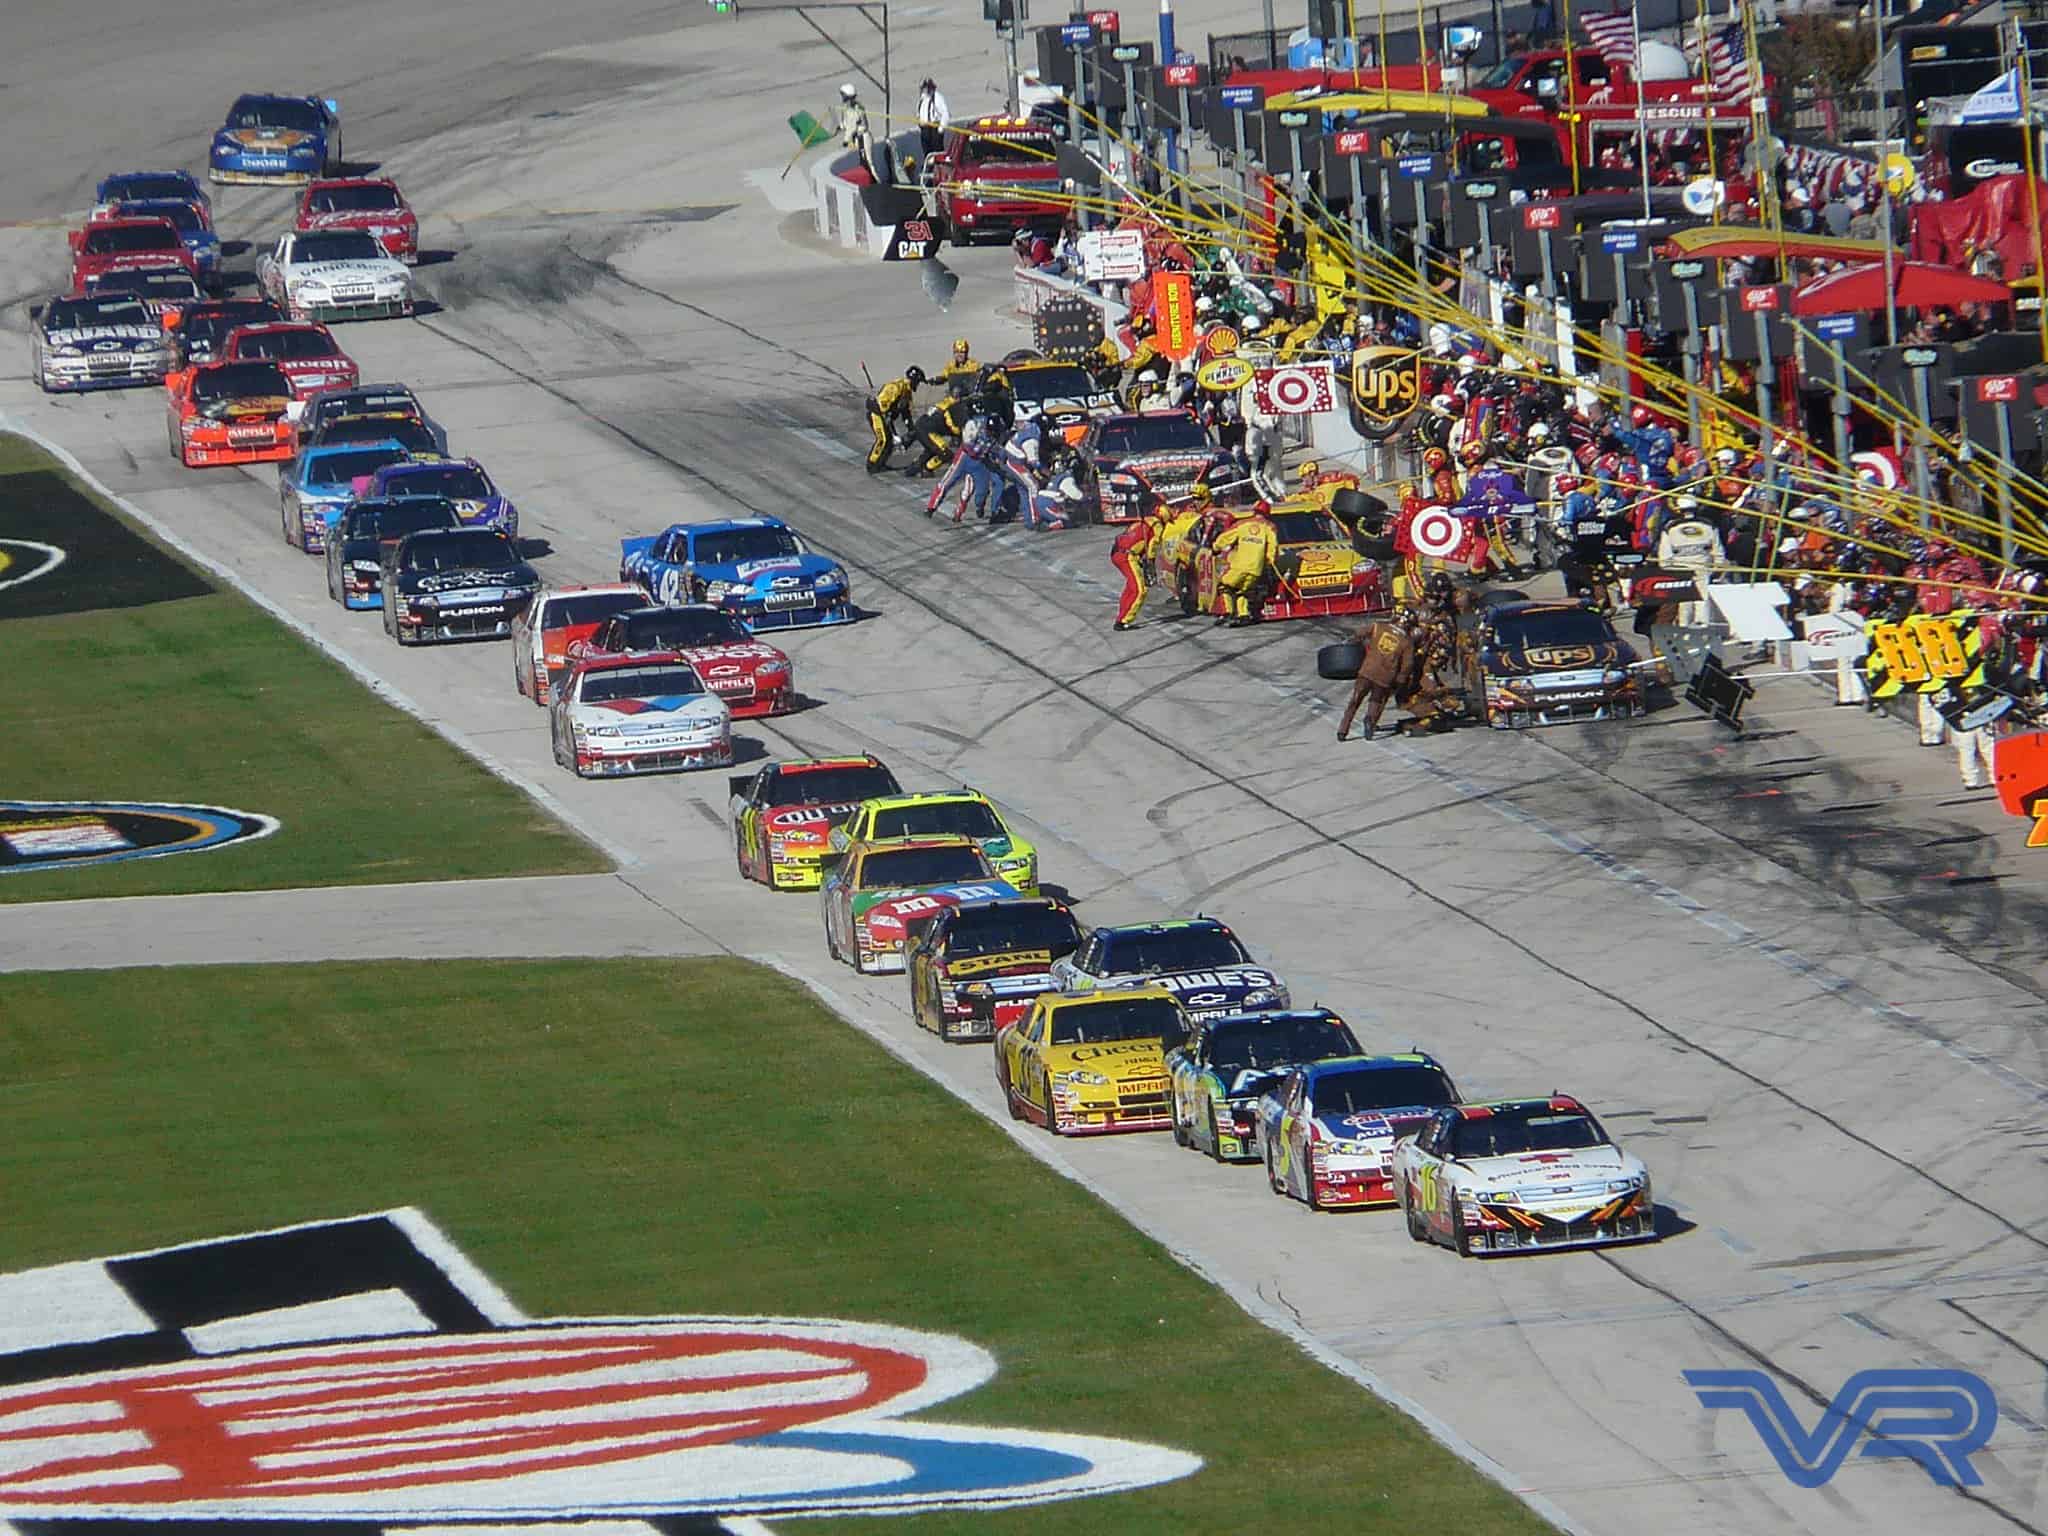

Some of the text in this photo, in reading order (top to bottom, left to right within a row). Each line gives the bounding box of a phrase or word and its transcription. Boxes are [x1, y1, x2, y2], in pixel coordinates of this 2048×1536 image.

[897, 241, 927, 258] CAT
[1205, 364, 1247, 383] PENNZOIL
[1358, 367, 1415, 409] ups
[1087, 392, 1114, 408] CAT
[764, 591, 816, 604] IMPALA
[439, 606, 505, 618] FUSION
[624, 735, 693, 747] FUSION
